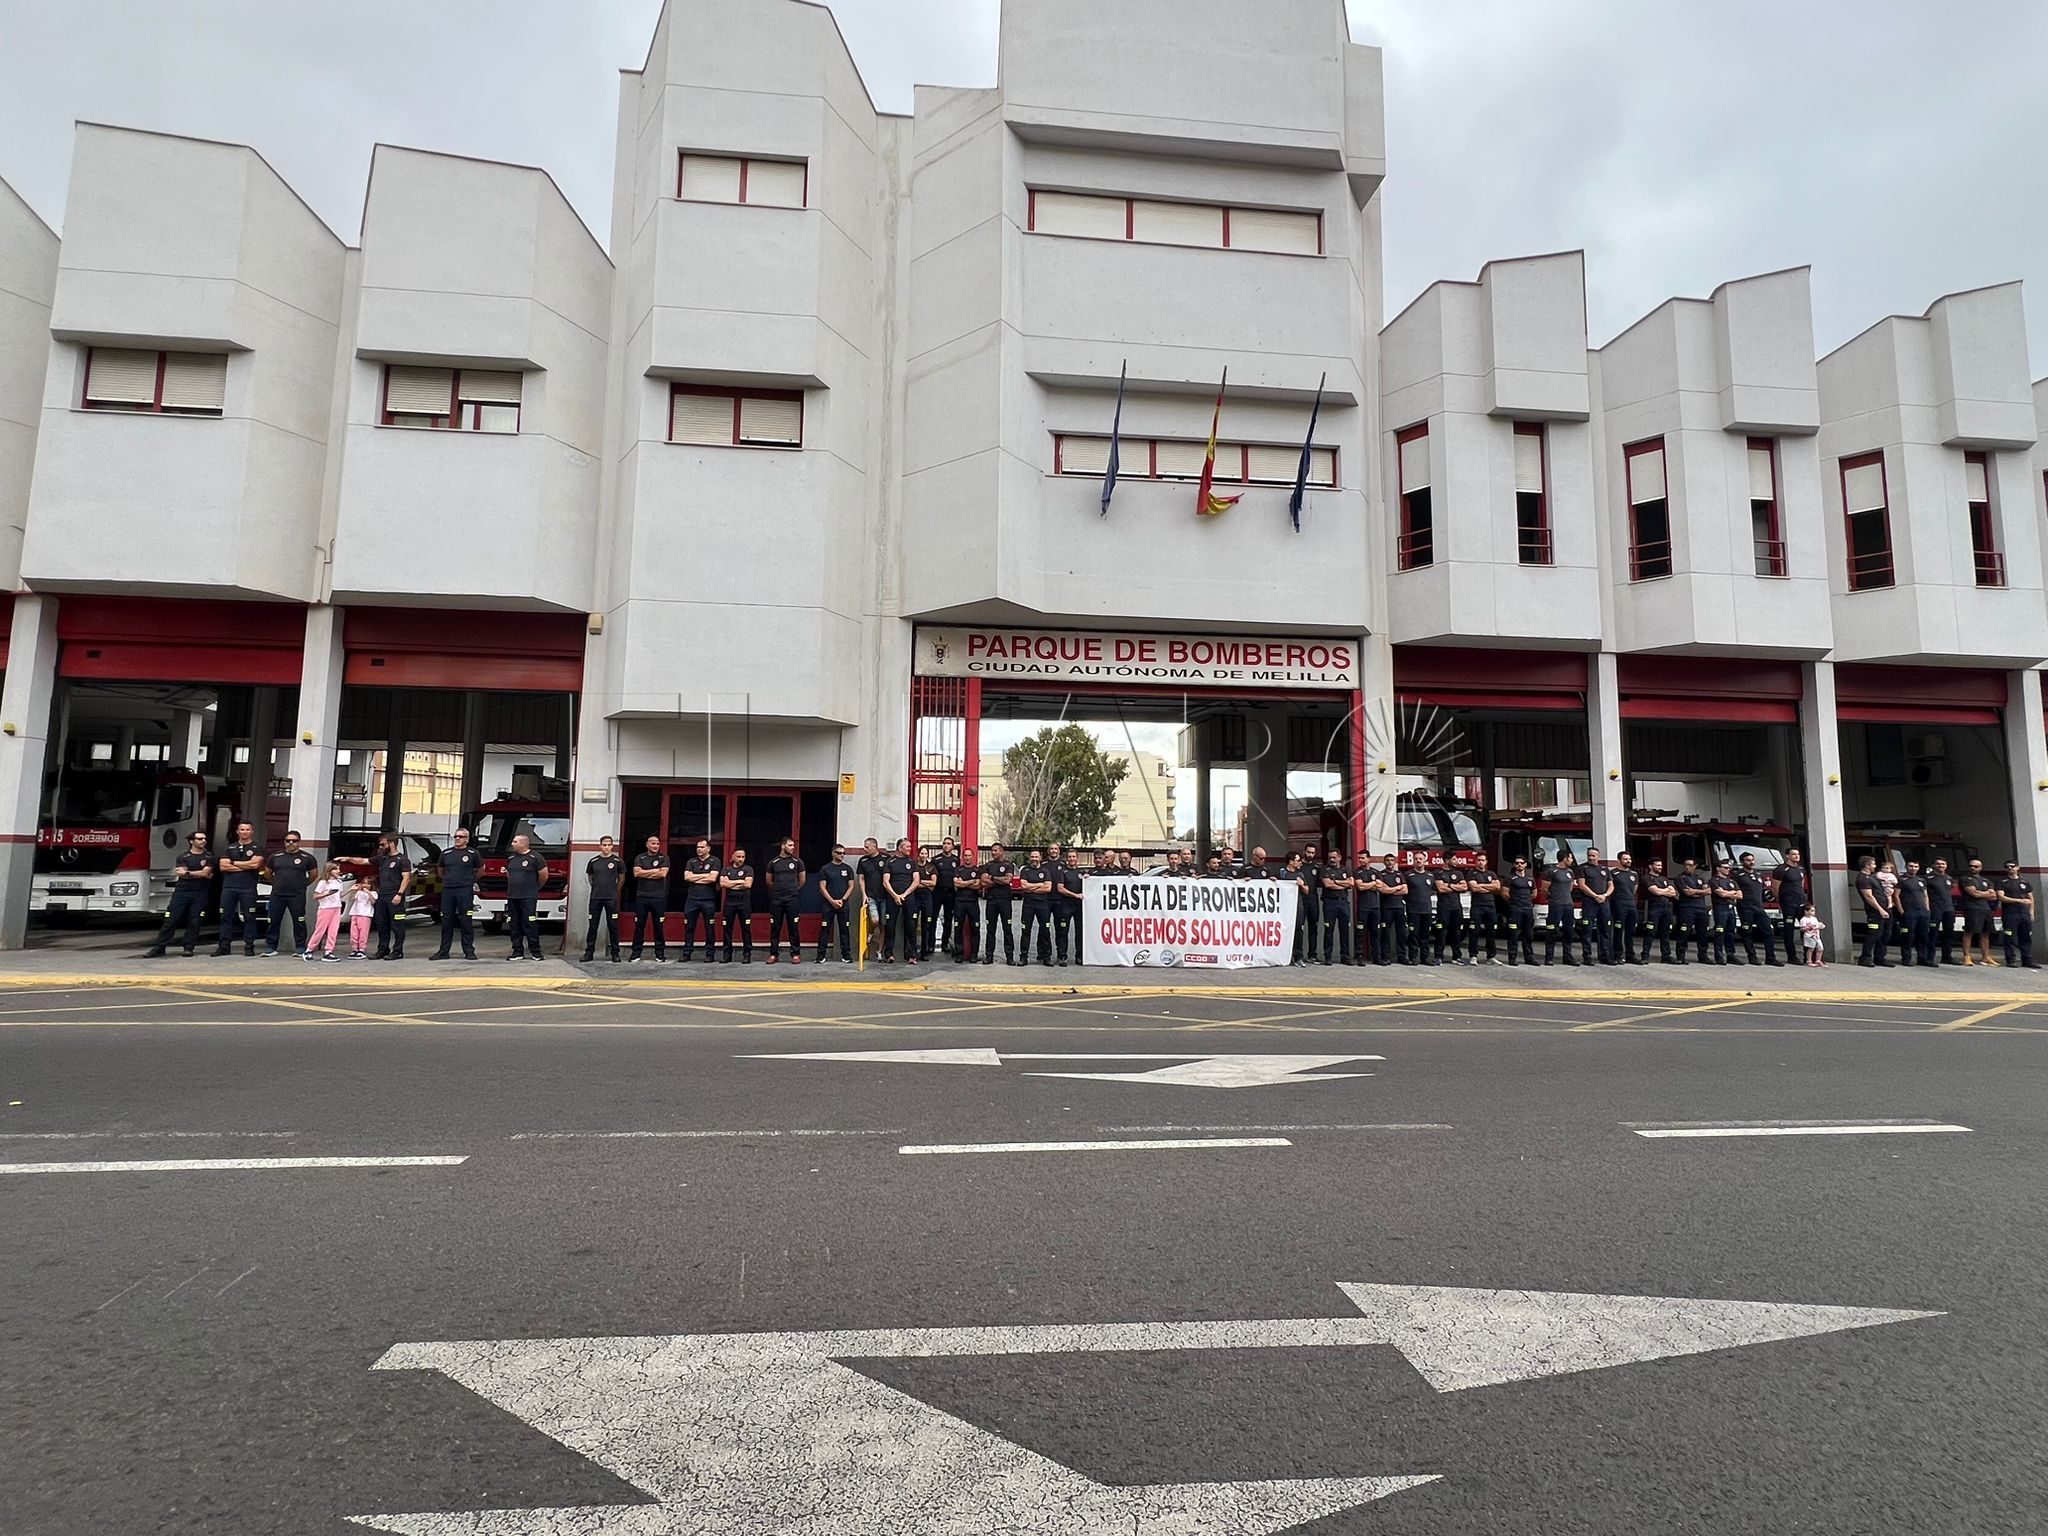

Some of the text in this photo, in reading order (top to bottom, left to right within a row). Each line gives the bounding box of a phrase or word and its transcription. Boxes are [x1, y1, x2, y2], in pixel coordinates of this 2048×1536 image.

[968, 634, 1351, 669] PARQUE DE BOMBEROS
[967, 662, 1350, 682] CIUDAD AUTÓNOMA DE MELILLA
[1102, 884, 1280, 913] ¡BASTA DE PROMESAS!
[1101, 918, 1281, 947] QUEREMOS SOLUCIONES
